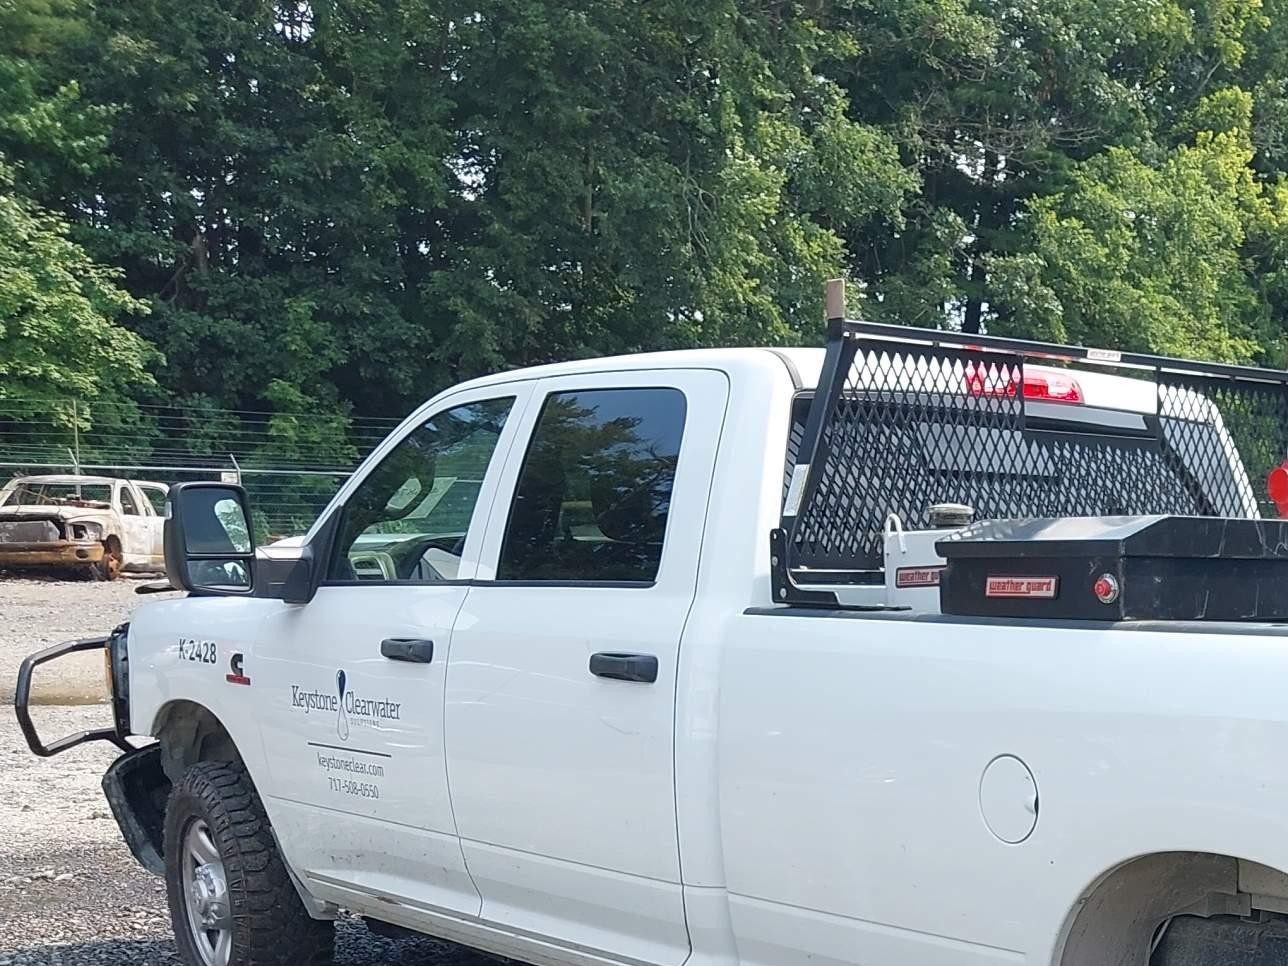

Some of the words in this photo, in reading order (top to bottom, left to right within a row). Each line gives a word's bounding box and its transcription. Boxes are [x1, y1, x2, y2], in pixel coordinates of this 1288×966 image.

[899, 570, 929, 581] weather
[989, 579, 1024, 592] weather
[1026, 580, 1052, 595] guard
[178, 638, 217, 664] K-2428
[291, 685, 338, 714] Keystone
[345, 691, 401, 720] Clearwater
[317, 752, 384, 777] keystoneclear.com
[328, 777, 379, 799] 717-508-0550
